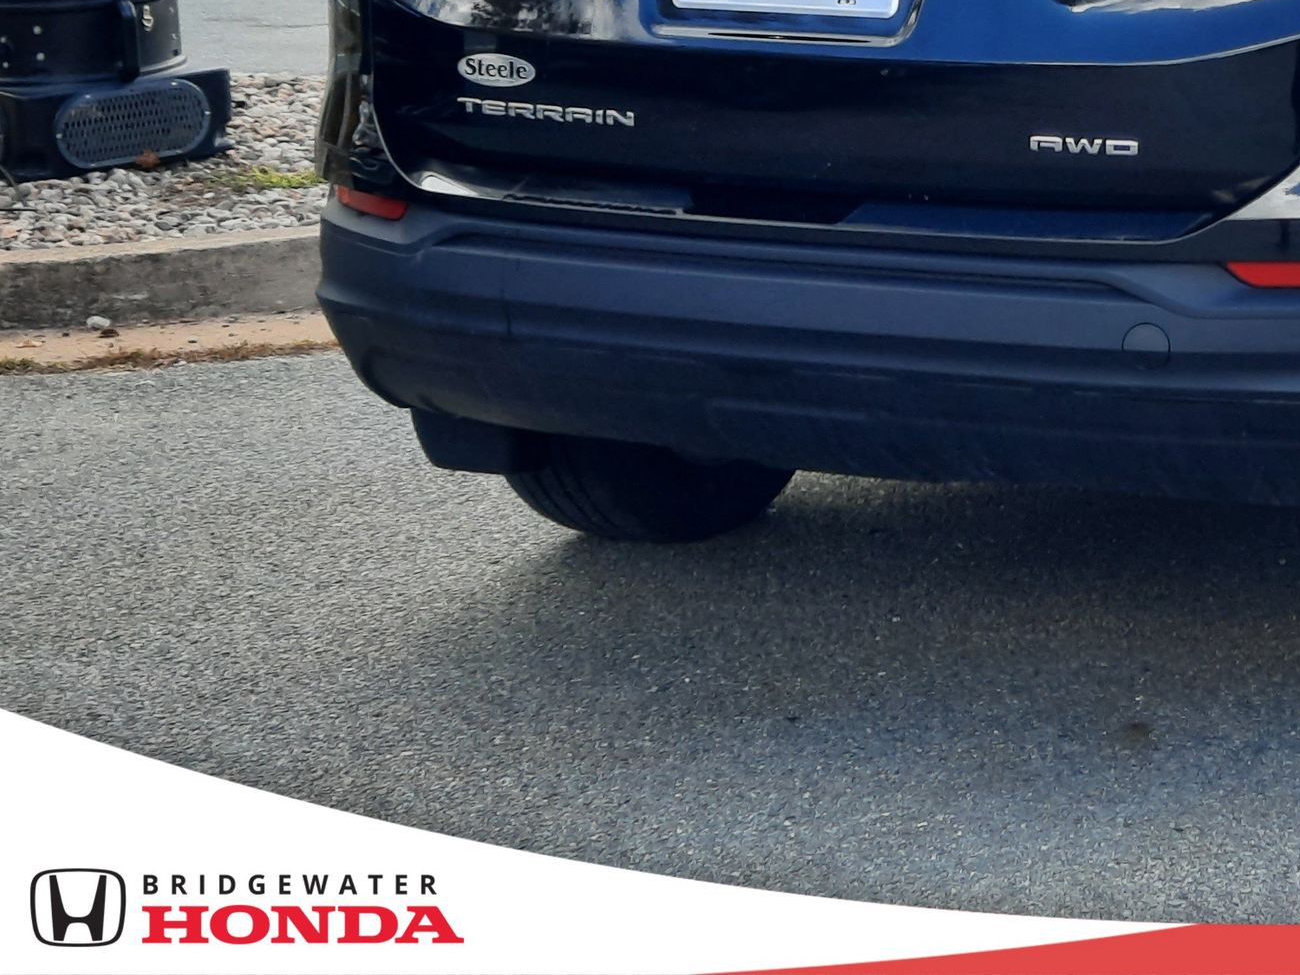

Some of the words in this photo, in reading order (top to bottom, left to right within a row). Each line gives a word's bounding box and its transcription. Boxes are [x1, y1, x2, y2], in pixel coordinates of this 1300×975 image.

[465, 58, 527, 79] Steele
[457, 97, 635, 127] TERRAIN
[1030, 135, 1139, 155] AWD
